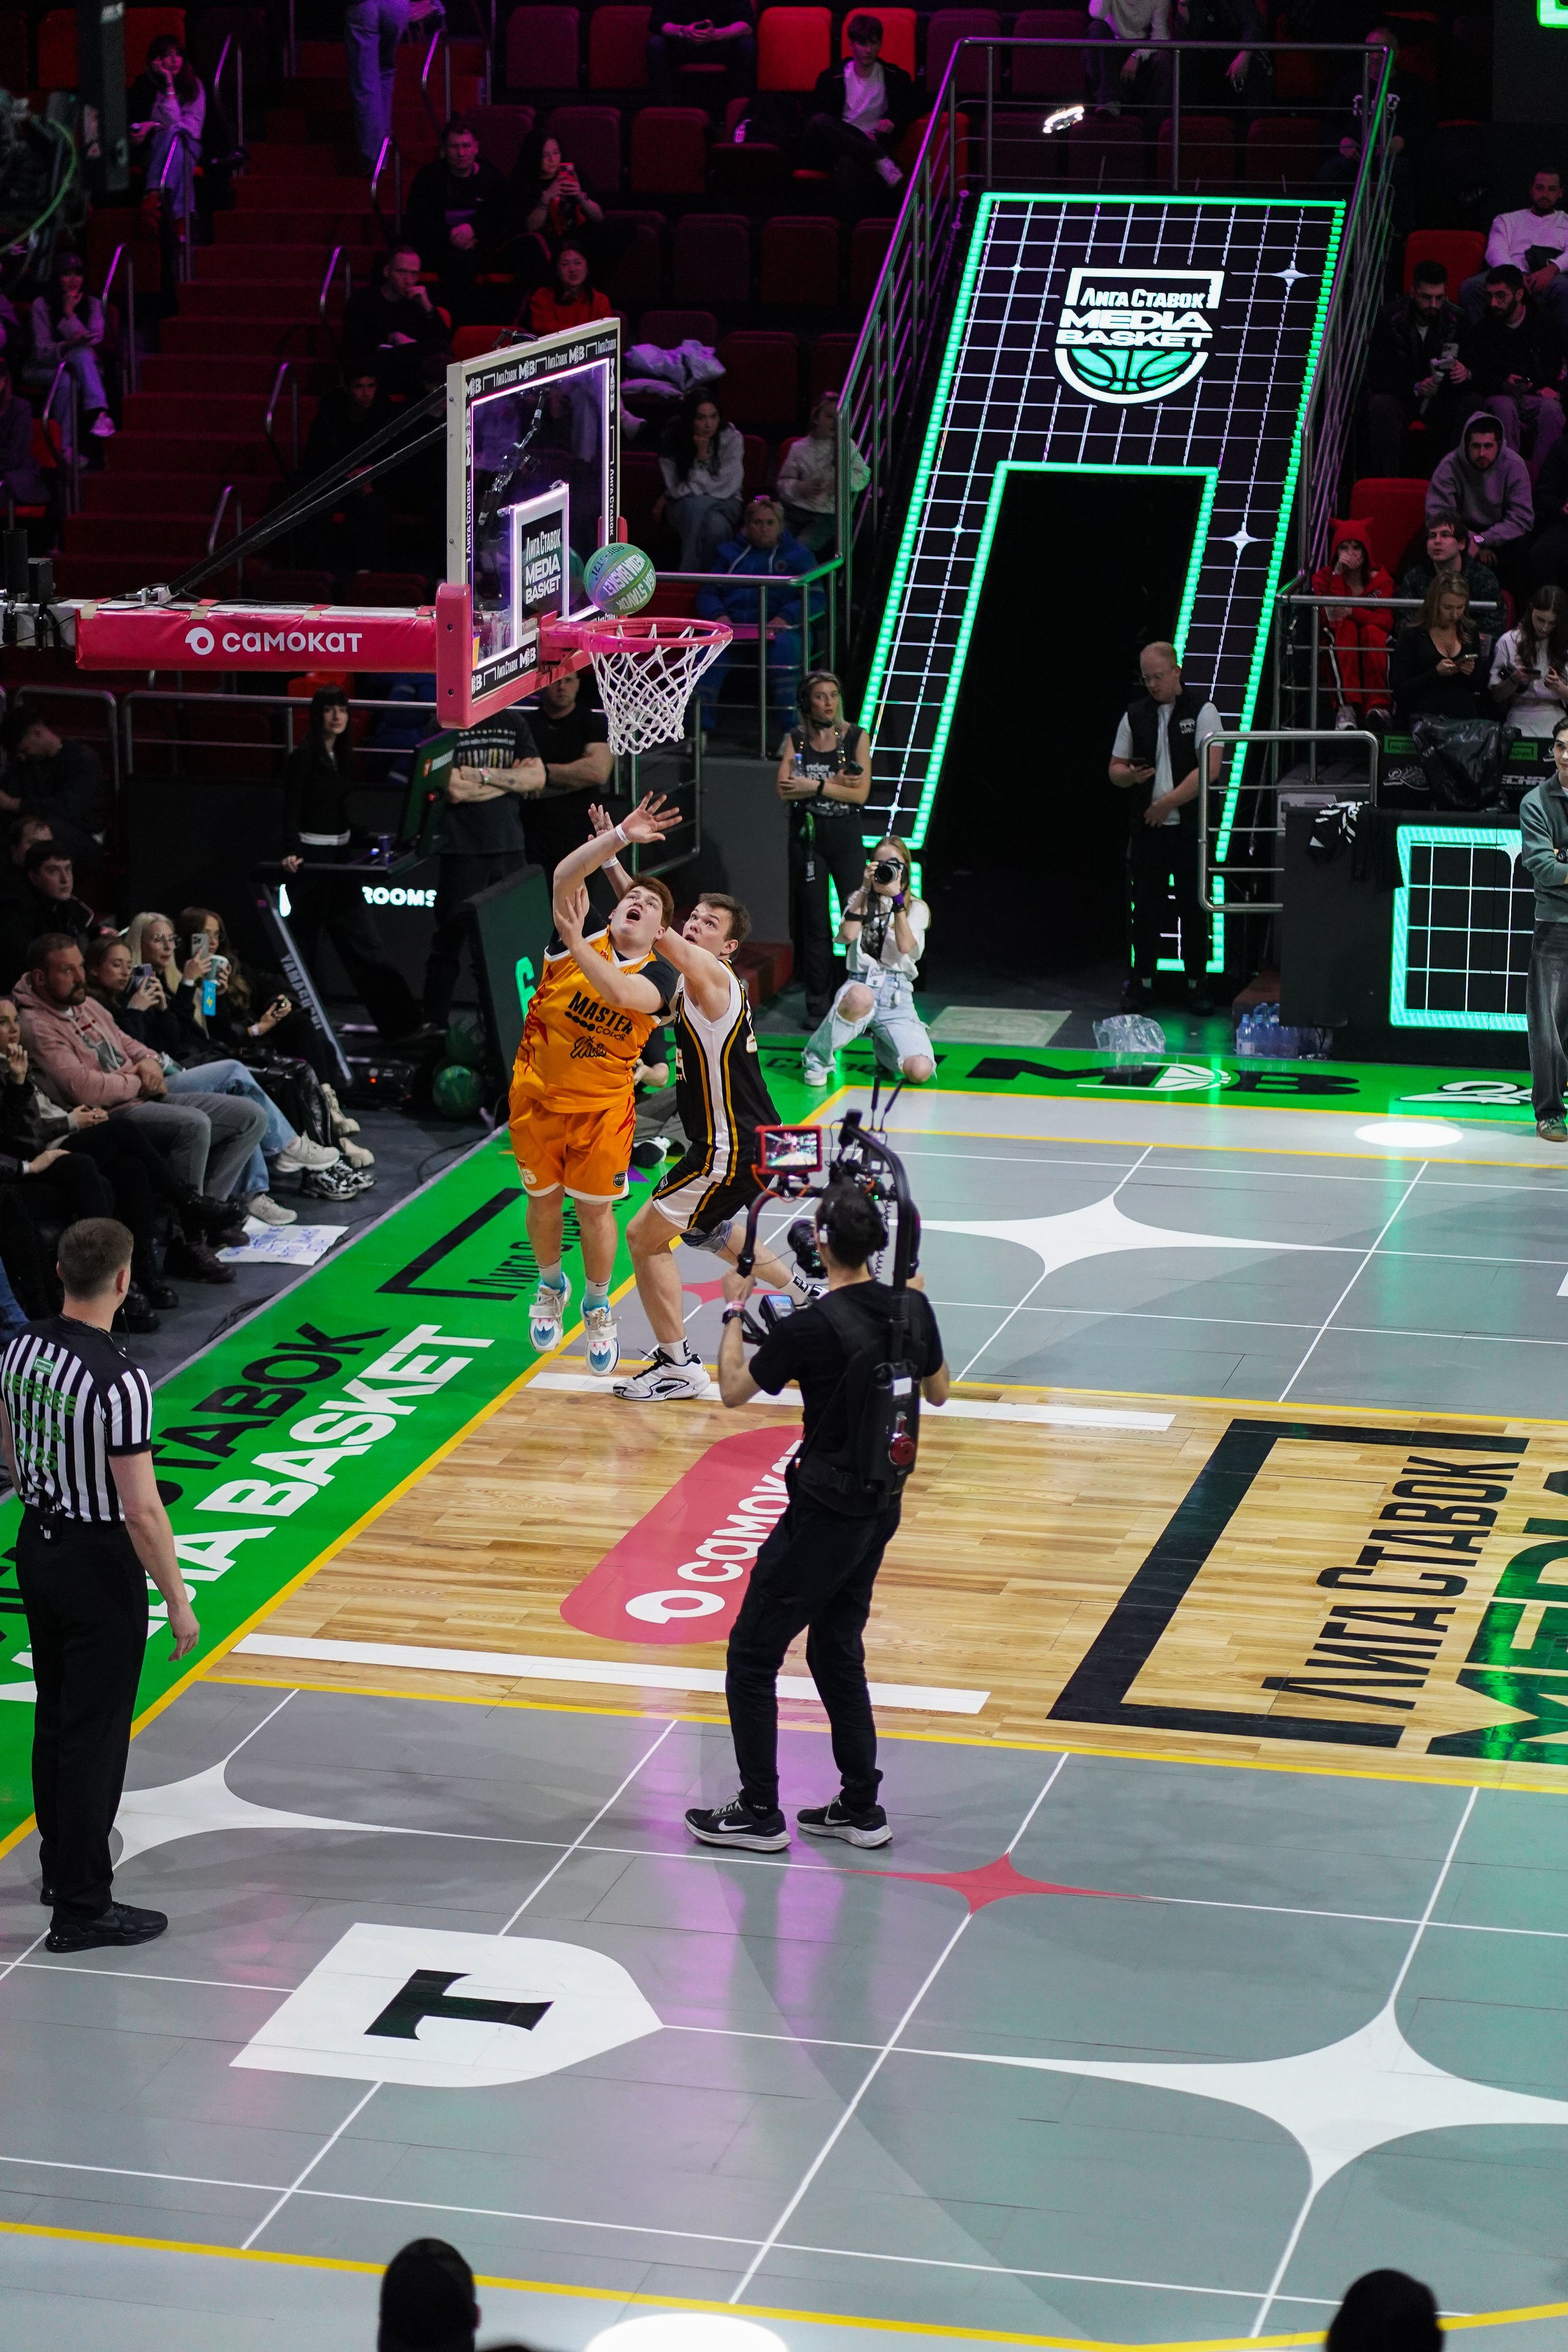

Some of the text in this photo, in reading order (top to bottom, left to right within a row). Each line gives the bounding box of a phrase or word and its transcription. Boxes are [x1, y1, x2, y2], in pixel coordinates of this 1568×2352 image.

[1059, 308, 1213, 331] MEDIA
[1055, 329, 1213, 348] BASKET
[526, 553, 561, 586] MEDIA
[603, 563, 634, 597] BASKET
[526, 574, 561, 605] BASKET
[568, 990, 633, 1035] MASTER
[595, 1025, 626, 1041] COLOR
[4, 1370, 77, 1417] REFEREE
[193, 1324, 496, 1517] BASKET
[15, 1437, 58, 1471] 2K25
[1261, 1455, 1520, 1710] ЛИГА СТАВОК
